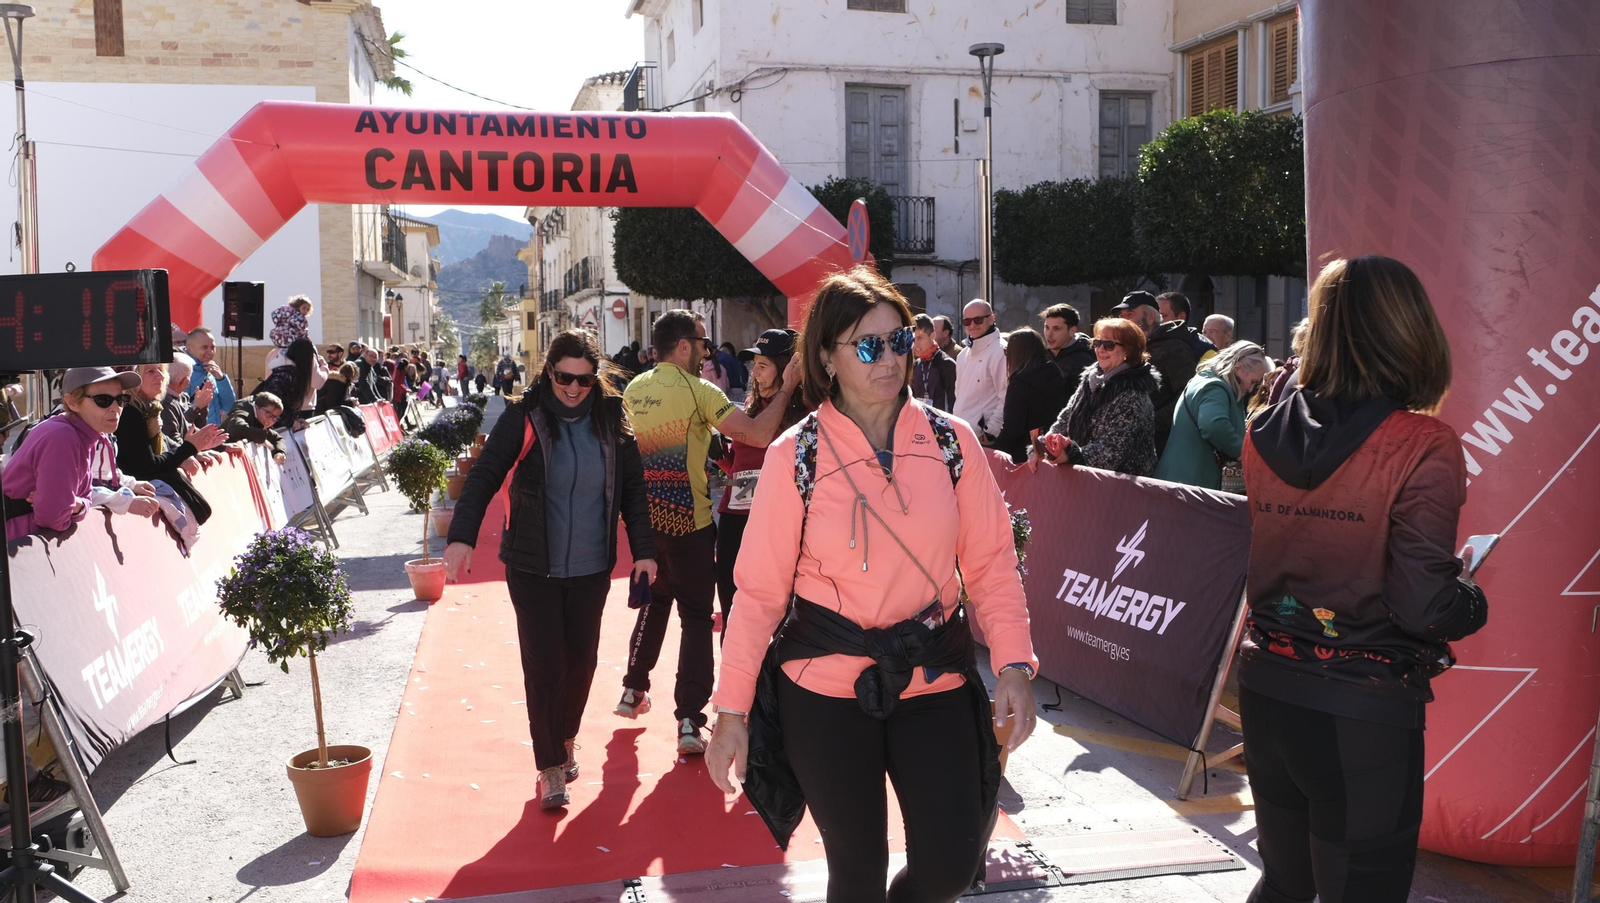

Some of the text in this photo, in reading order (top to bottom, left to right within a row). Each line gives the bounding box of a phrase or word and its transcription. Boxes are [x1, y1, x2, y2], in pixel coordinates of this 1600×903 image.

[354, 110, 647, 139] AYUNTAMIENTO
[364, 147, 638, 193] CANTORIA
[1278, 504, 1291, 516] DE
[1294, 507, 1365, 523] ALMANZORA
[1056, 568, 1187, 635] TEAMERGY
[635, 632, 643, 647] NON
[1067, 625, 1130, 661] www.teamergy.es
[81, 616, 165, 710] TEAMERGY
